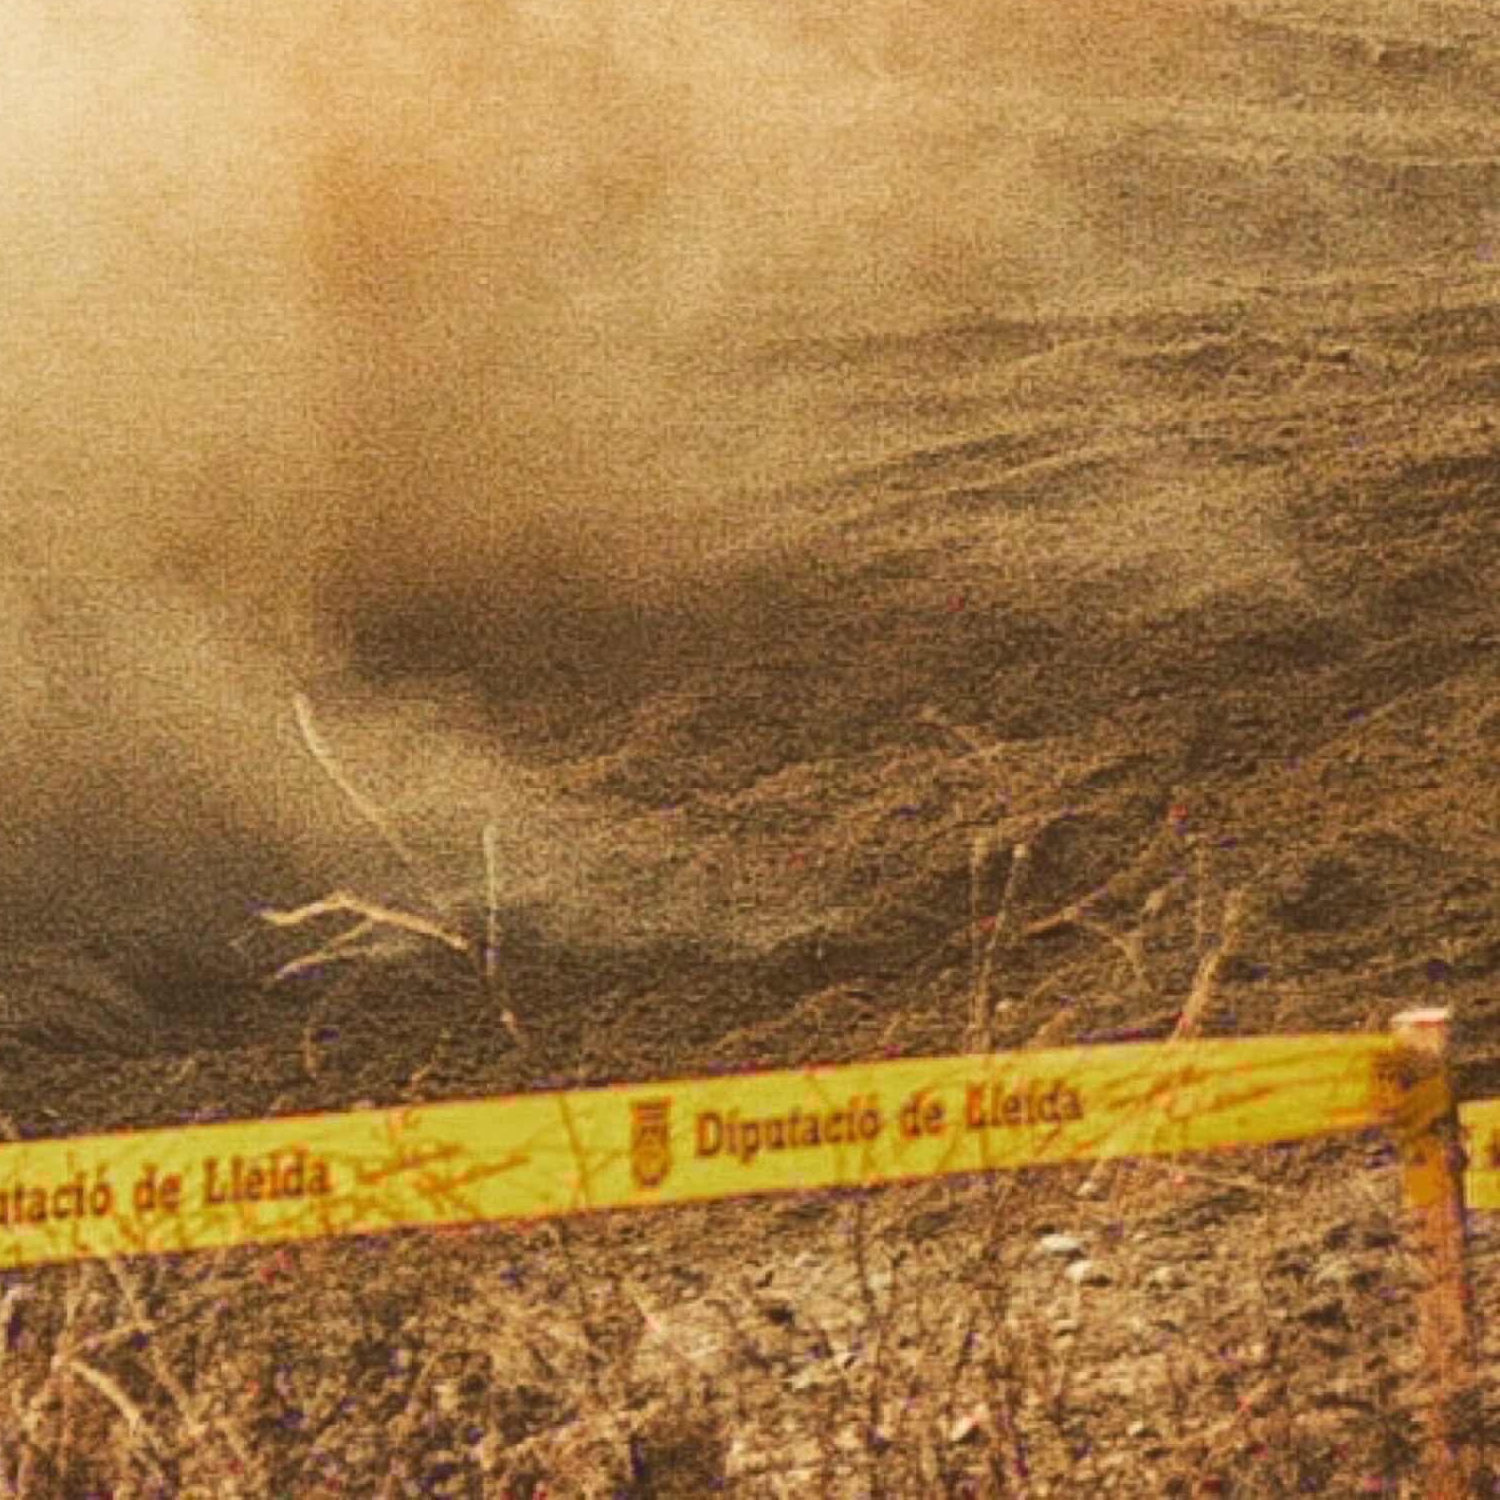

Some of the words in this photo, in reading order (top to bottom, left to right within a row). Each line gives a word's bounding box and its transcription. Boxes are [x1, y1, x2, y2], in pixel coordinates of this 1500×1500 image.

[694, 1095, 883, 1163] Diputació
[901, 1090, 945, 1139] de
[965, 1076, 1083, 1133] Lleida
[133, 1166, 181, 1213] de
[203, 1146, 332, 1204] Lleida
